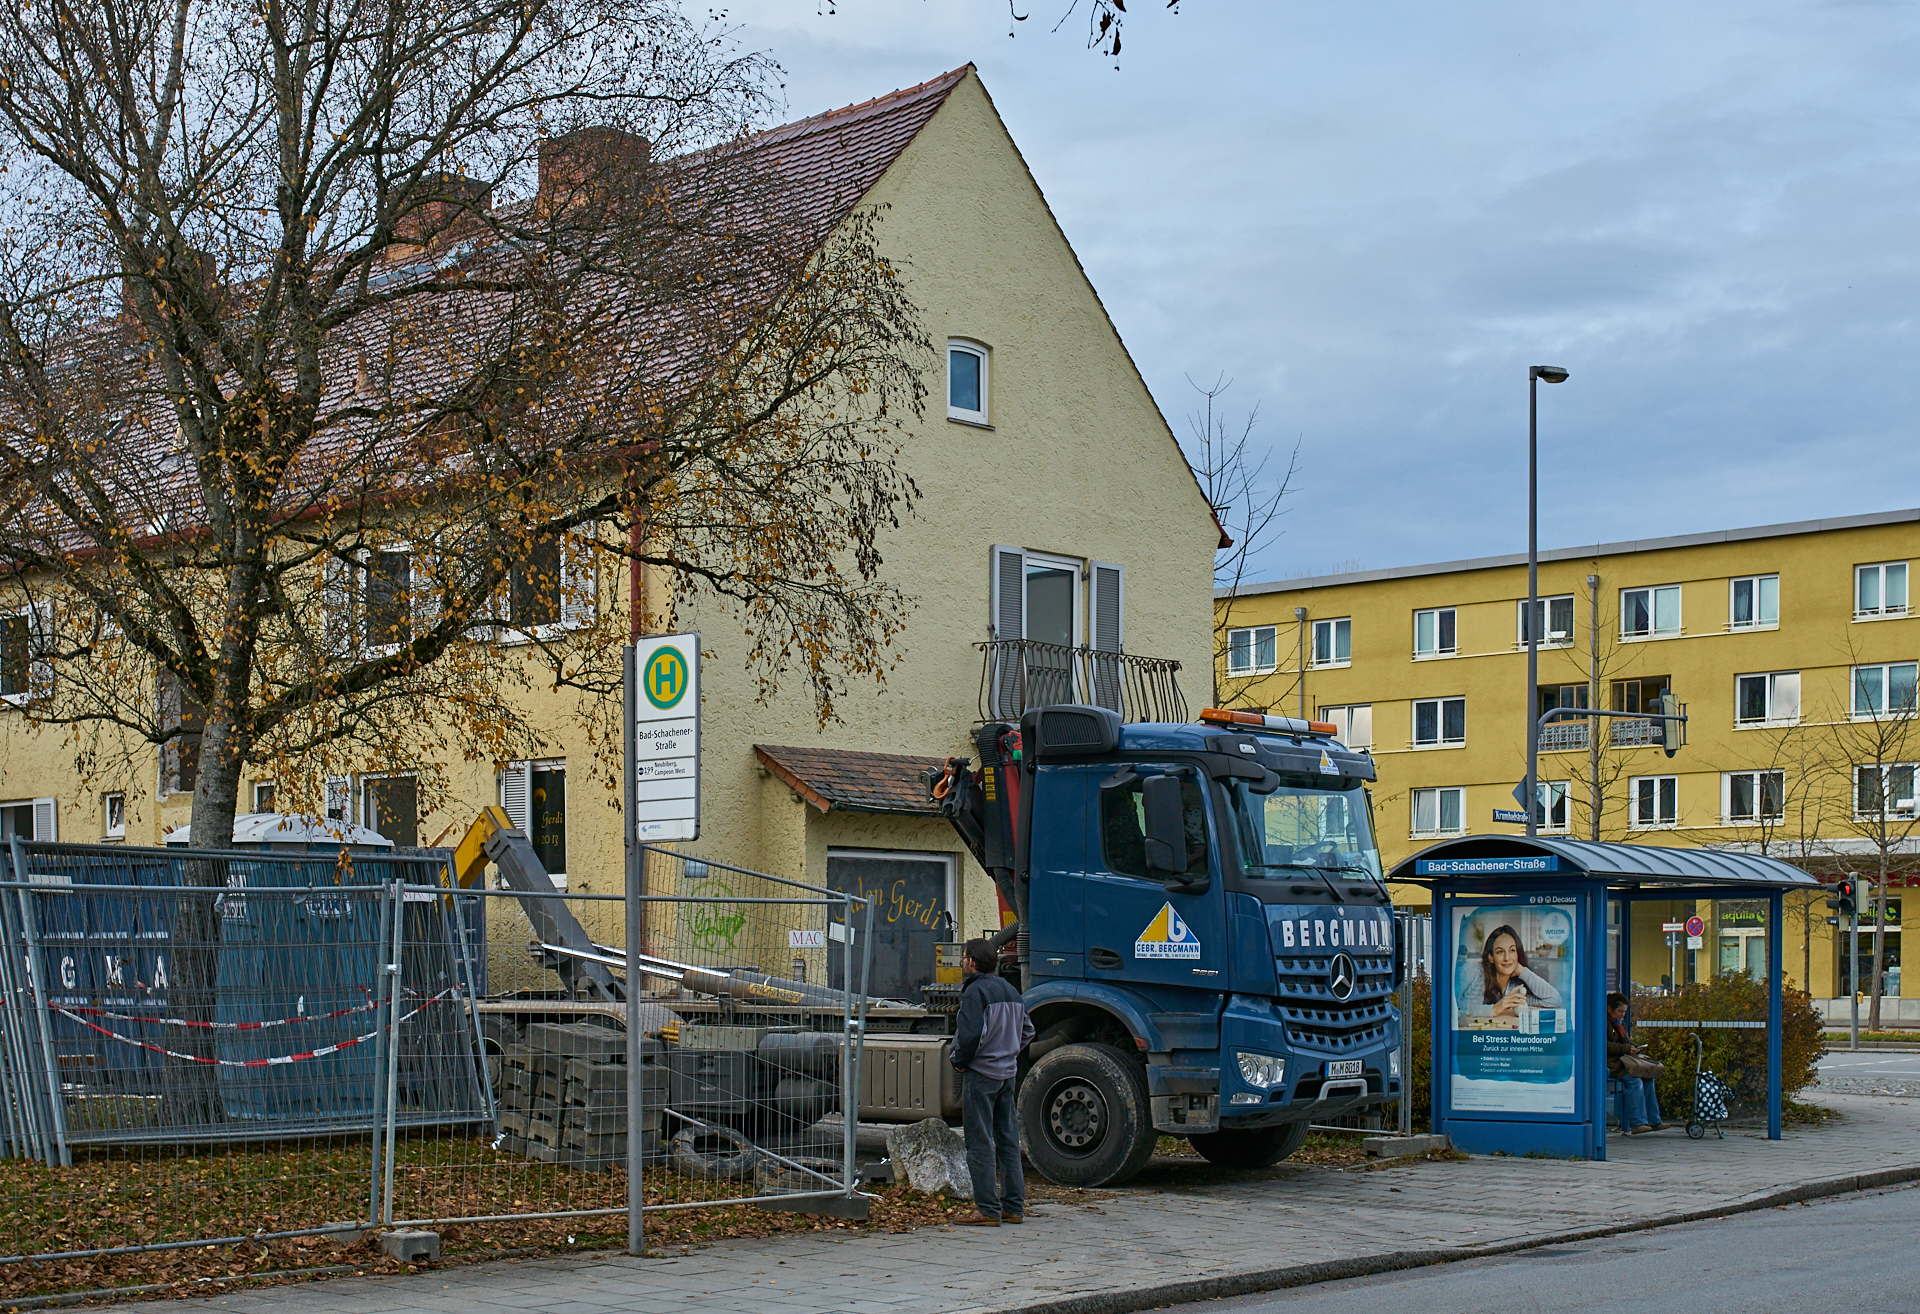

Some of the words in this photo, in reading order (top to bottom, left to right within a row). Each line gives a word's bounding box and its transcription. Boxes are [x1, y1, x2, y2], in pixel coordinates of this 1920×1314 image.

[655, 660, 677, 696] H
[639, 728, 693, 740] Bad-Schachener-
[655, 740, 677, 751] Straße
[644, 766, 654, 774] 199
[541, 811, 563, 829] Gerdi
[1428, 859, 1546, 872] Bad-Schachener-Straße
[887, 879, 942, 930] Gerdi
[1722, 910, 1755, 922] aquila
[792, 931, 822, 945] MAC
[1282, 919, 1389, 947] BERGMANN
[1136, 944, 1157, 953] GEBR.
[1158, 944, 1199, 953] BERGMANN
[1472, 1035, 1484, 1043] Bei
[1485, 1035, 1509, 1043] Stress:
